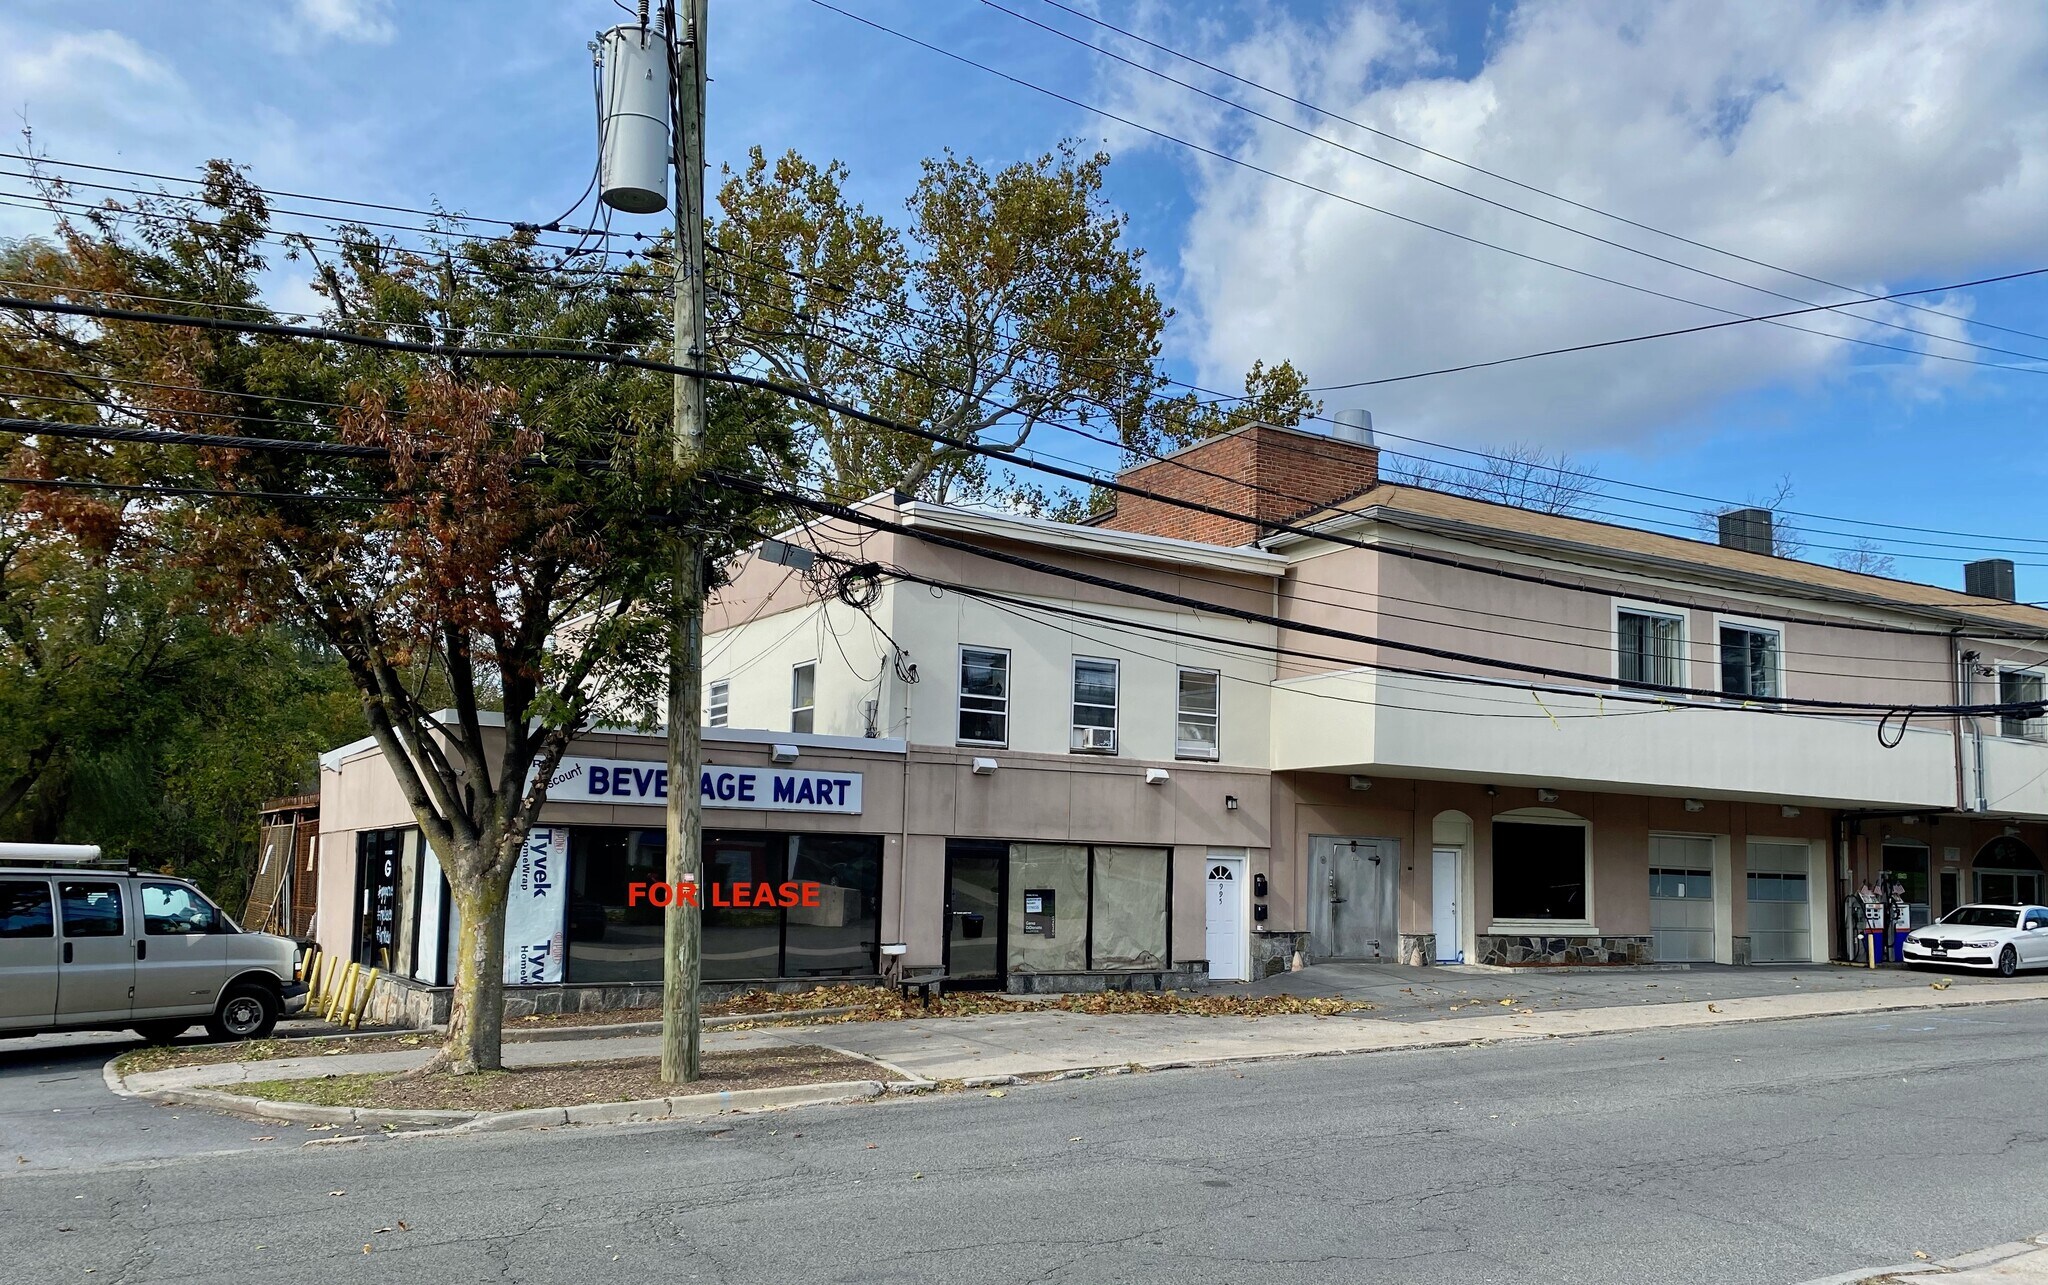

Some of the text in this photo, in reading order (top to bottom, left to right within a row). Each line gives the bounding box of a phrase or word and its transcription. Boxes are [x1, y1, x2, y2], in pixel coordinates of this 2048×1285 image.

[541, 763, 582, 790] scount
[588, 766, 851, 806] BEVEAGE MART
[530, 829, 552, 898] Tyvek
[528, 940, 551, 984] Tyv
